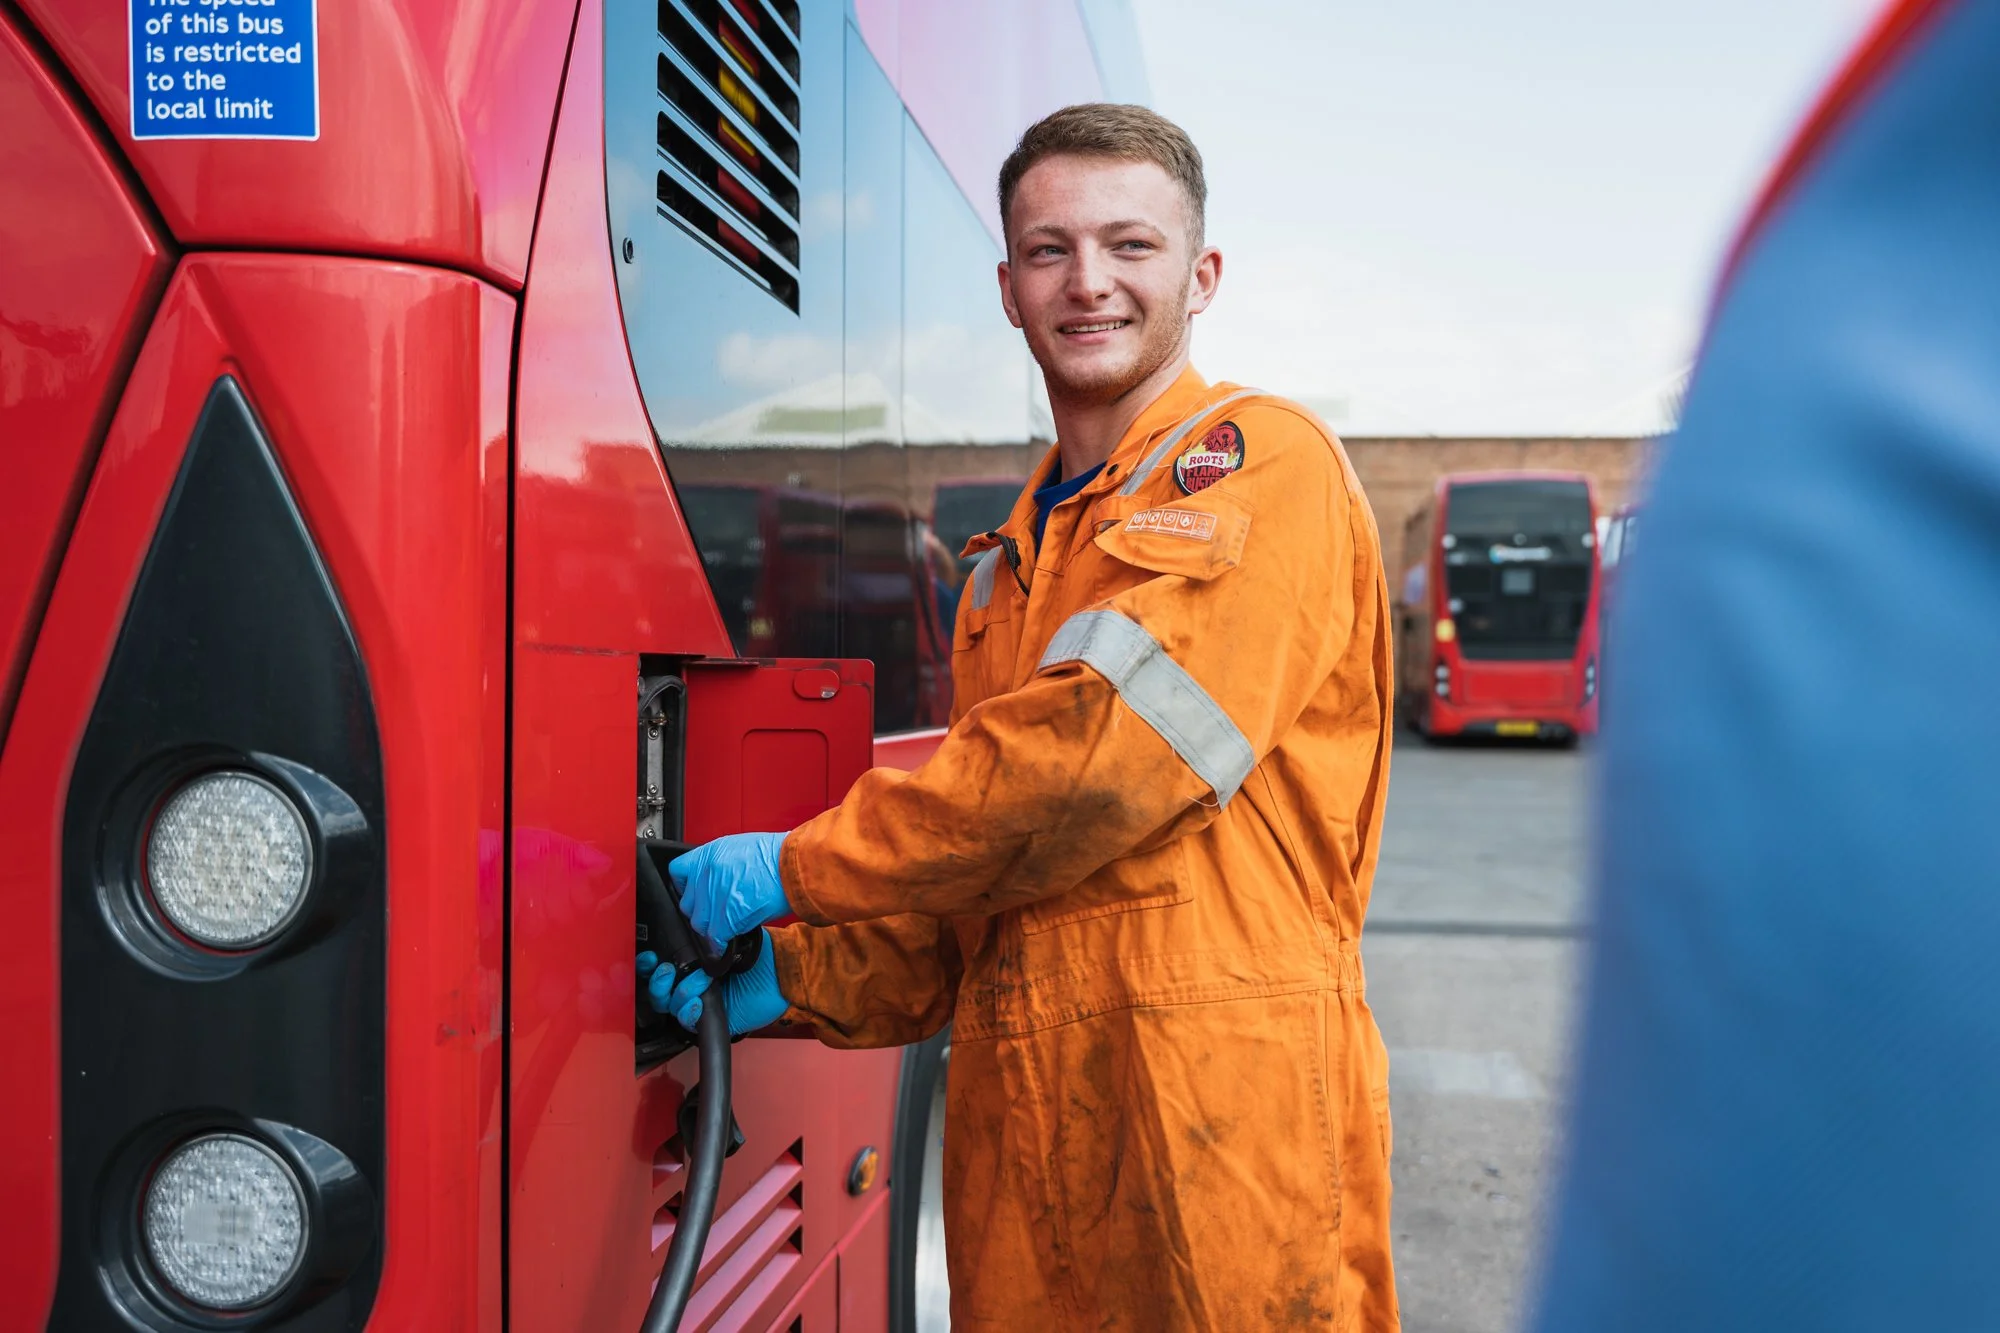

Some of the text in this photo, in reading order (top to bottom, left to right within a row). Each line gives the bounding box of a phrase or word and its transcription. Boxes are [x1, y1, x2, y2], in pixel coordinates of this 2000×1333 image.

[145, 12, 284, 35] of this bus
[146, 40, 301, 63] is restricted
[146, 69, 226, 91] to the
[147, 97, 274, 120] local limit
[1186, 465, 1223, 477] FLAME
[1188, 455, 1225, 466] ROOTS
